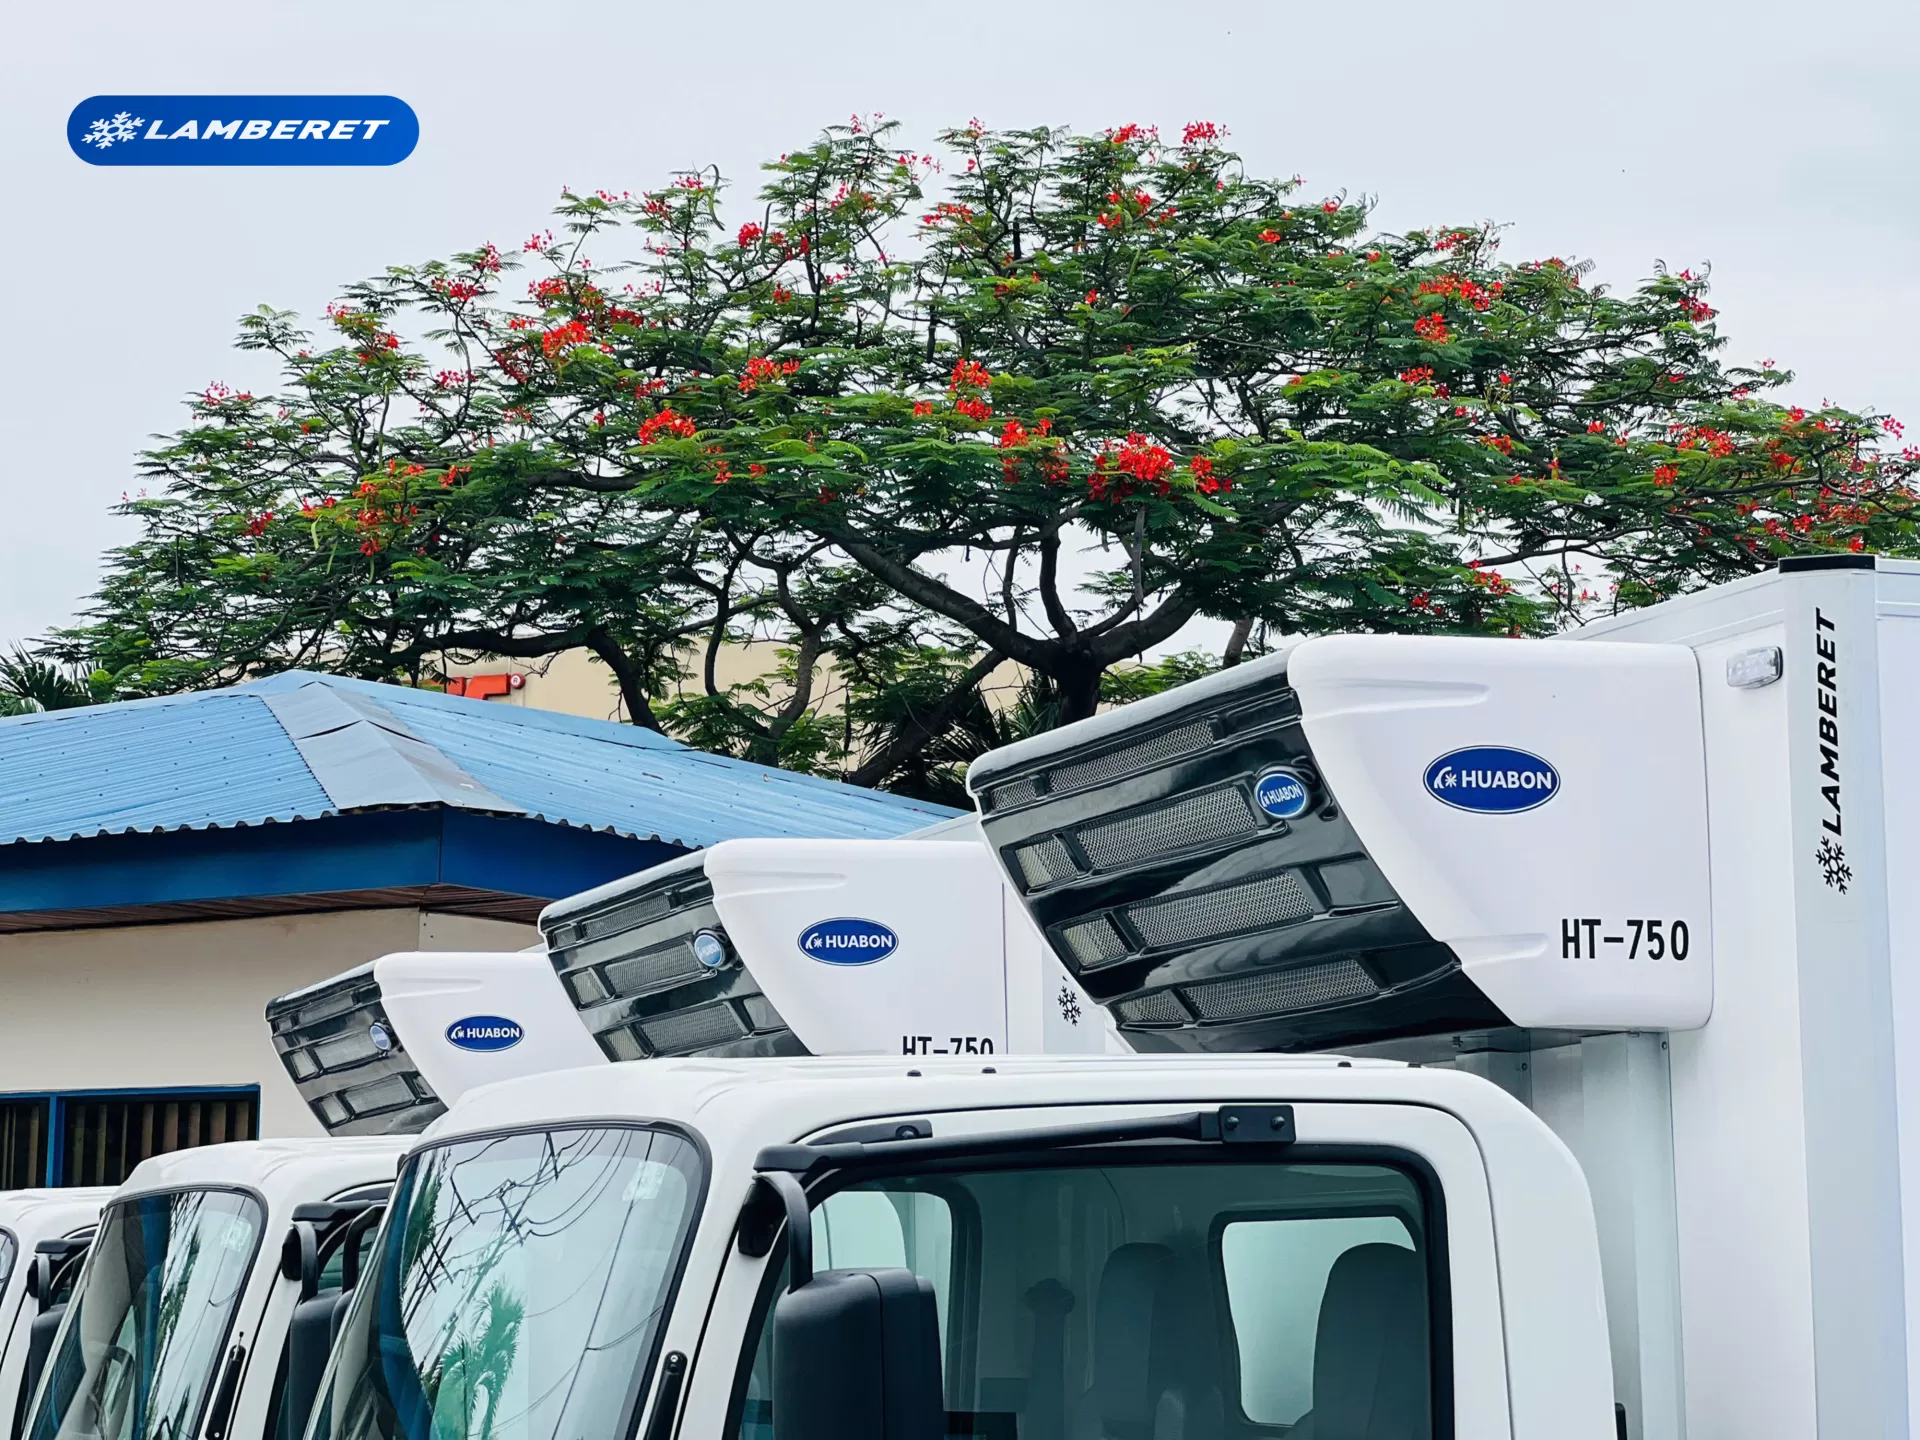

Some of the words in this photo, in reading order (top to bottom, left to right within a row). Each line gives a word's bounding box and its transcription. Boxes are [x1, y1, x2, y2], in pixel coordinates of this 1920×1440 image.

[1815, 606, 1842, 837] LAMBERET
[1461, 769, 1553, 790] HUABON
[1266, 783, 1303, 805] HUABON
[825, 934, 893, 949] HUABON
[1561, 918, 1690, 961] HT-750
[466, 1027, 520, 1039] HUABON
